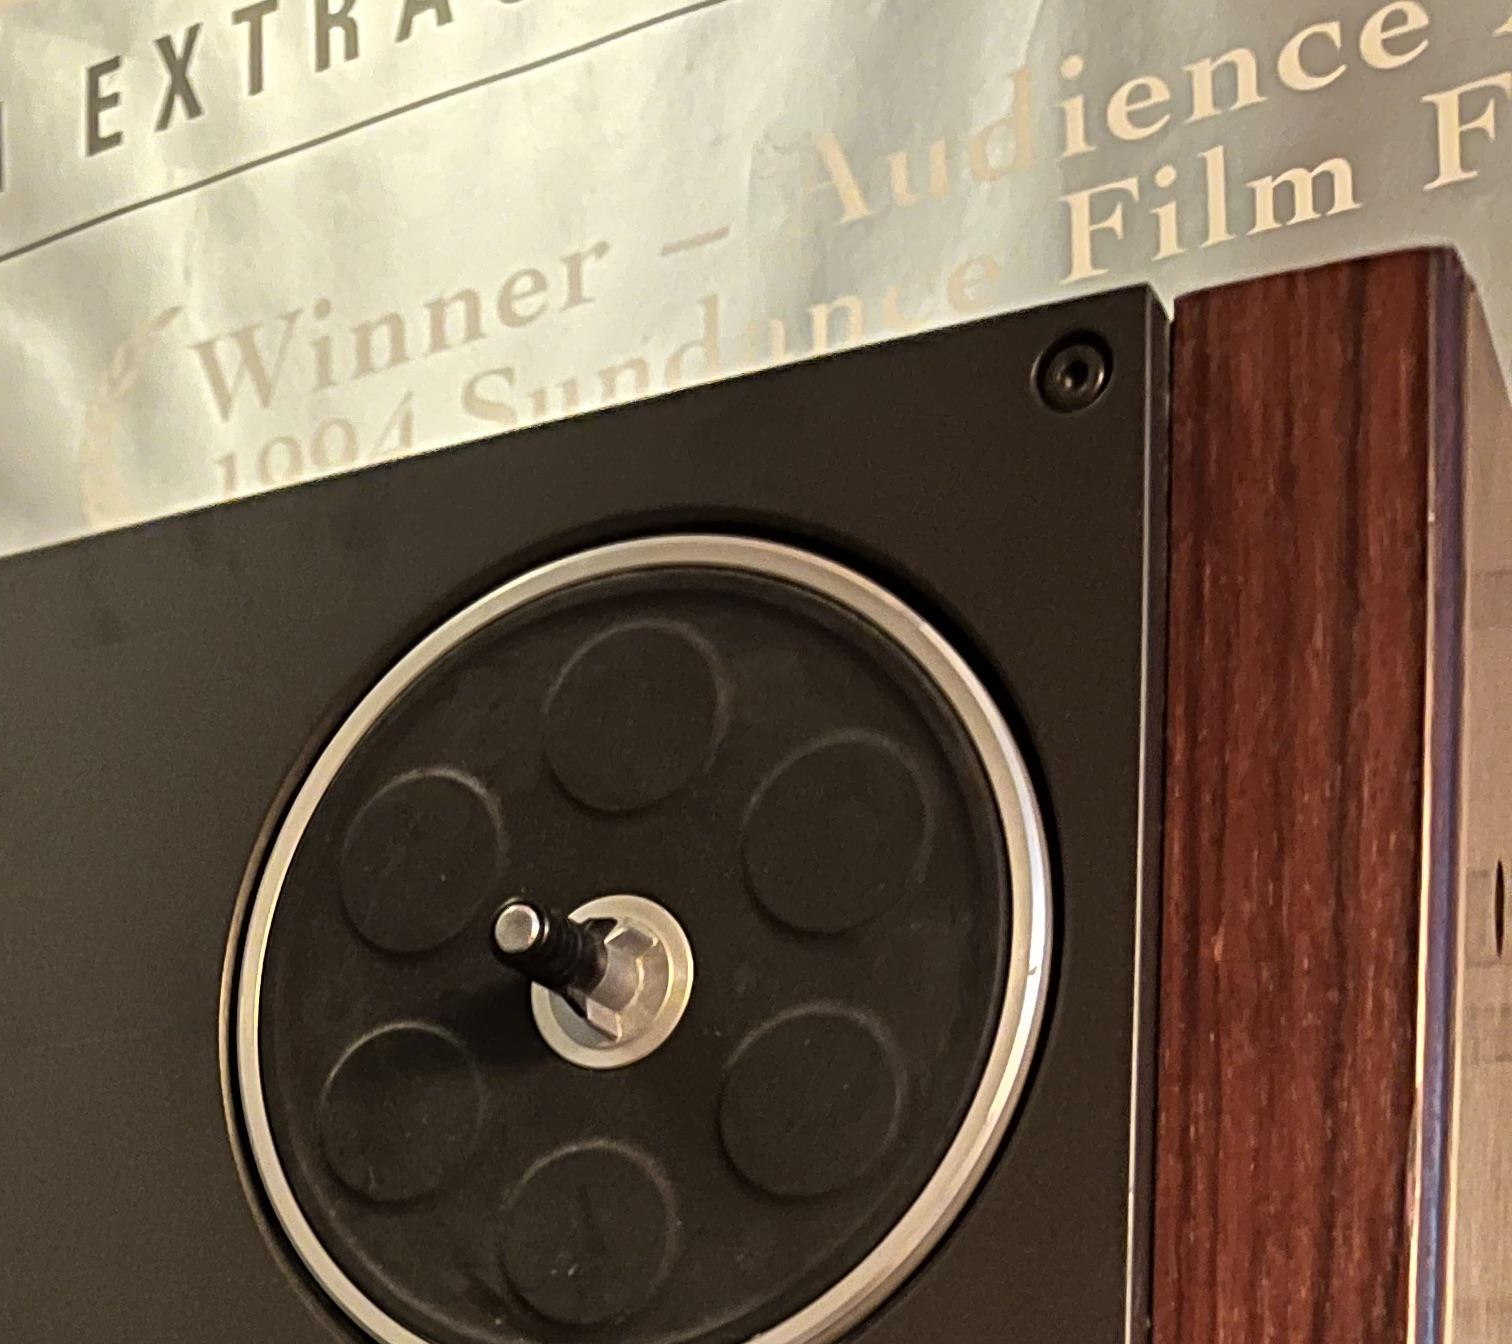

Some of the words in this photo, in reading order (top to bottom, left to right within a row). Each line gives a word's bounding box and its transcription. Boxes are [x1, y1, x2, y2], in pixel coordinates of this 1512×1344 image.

[86, 0, 525, 156] EXTR
[190, 239, 610, 422] Winner
[790, 0, 1430, 224] Audience
[1060, 146, 1362, 285] Film
